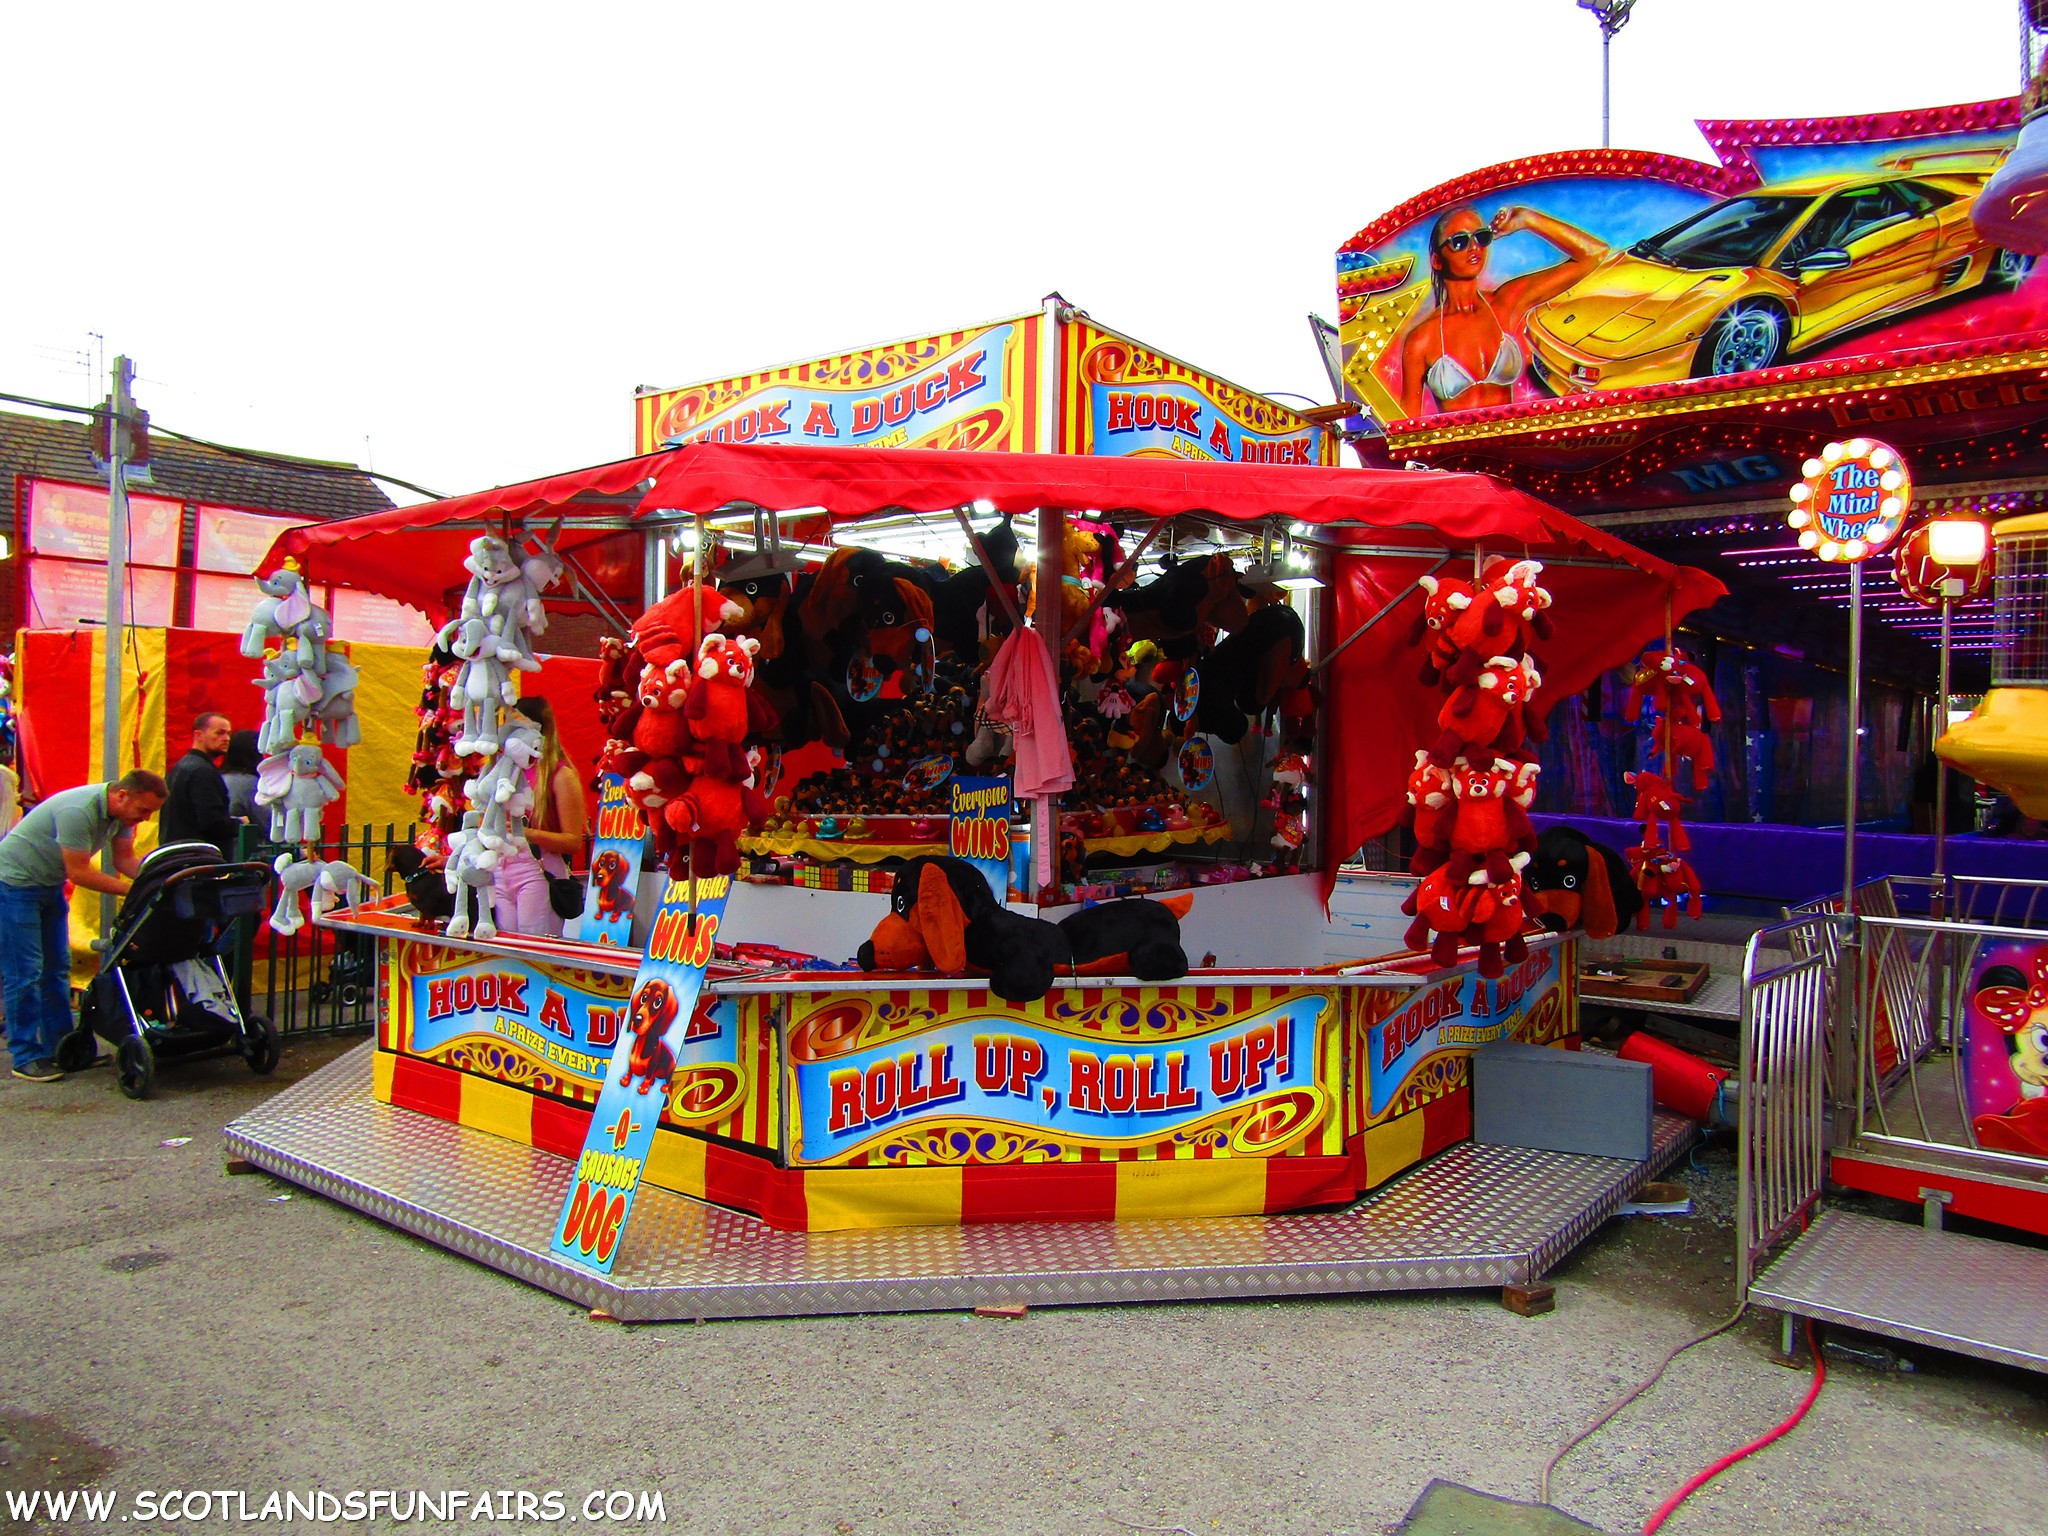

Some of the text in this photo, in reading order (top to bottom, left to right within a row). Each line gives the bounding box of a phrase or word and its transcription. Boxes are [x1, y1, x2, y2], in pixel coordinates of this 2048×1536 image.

[802, 401, 839, 437] A
[851, 350, 987, 436] DUCK
[1107, 391, 1312, 466] HOOK A DUCK
[1171, 434, 1182, 453] A
[1669, 455, 1781, 493] MG
[1830, 463, 1880, 491] The
[1827, 490, 1879, 515] Mini
[952, 783, 1009, 820] Everyone
[951, 816, 1010, 861] WINS
[428, 972, 722, 1048] HOOK A DK
[1382, 945, 1553, 1075] HOOK A DUCK
[494, 1016, 507, 1034] A
[507, 1023, 546, 1055] PRIZE
[547, 1042, 602, 1076] EVERY
[1437, 1027, 1446, 1045] A
[1447, 1025, 1476, 1043] PRIZE
[1476, 1021, 1502, 1043] EVERY
[828, 1014, 1295, 1134] ROLL UP, ROLL UP!
[577, 1148, 642, 1192] SAUSAGE
[561, 1180, 627, 1263] DOG
